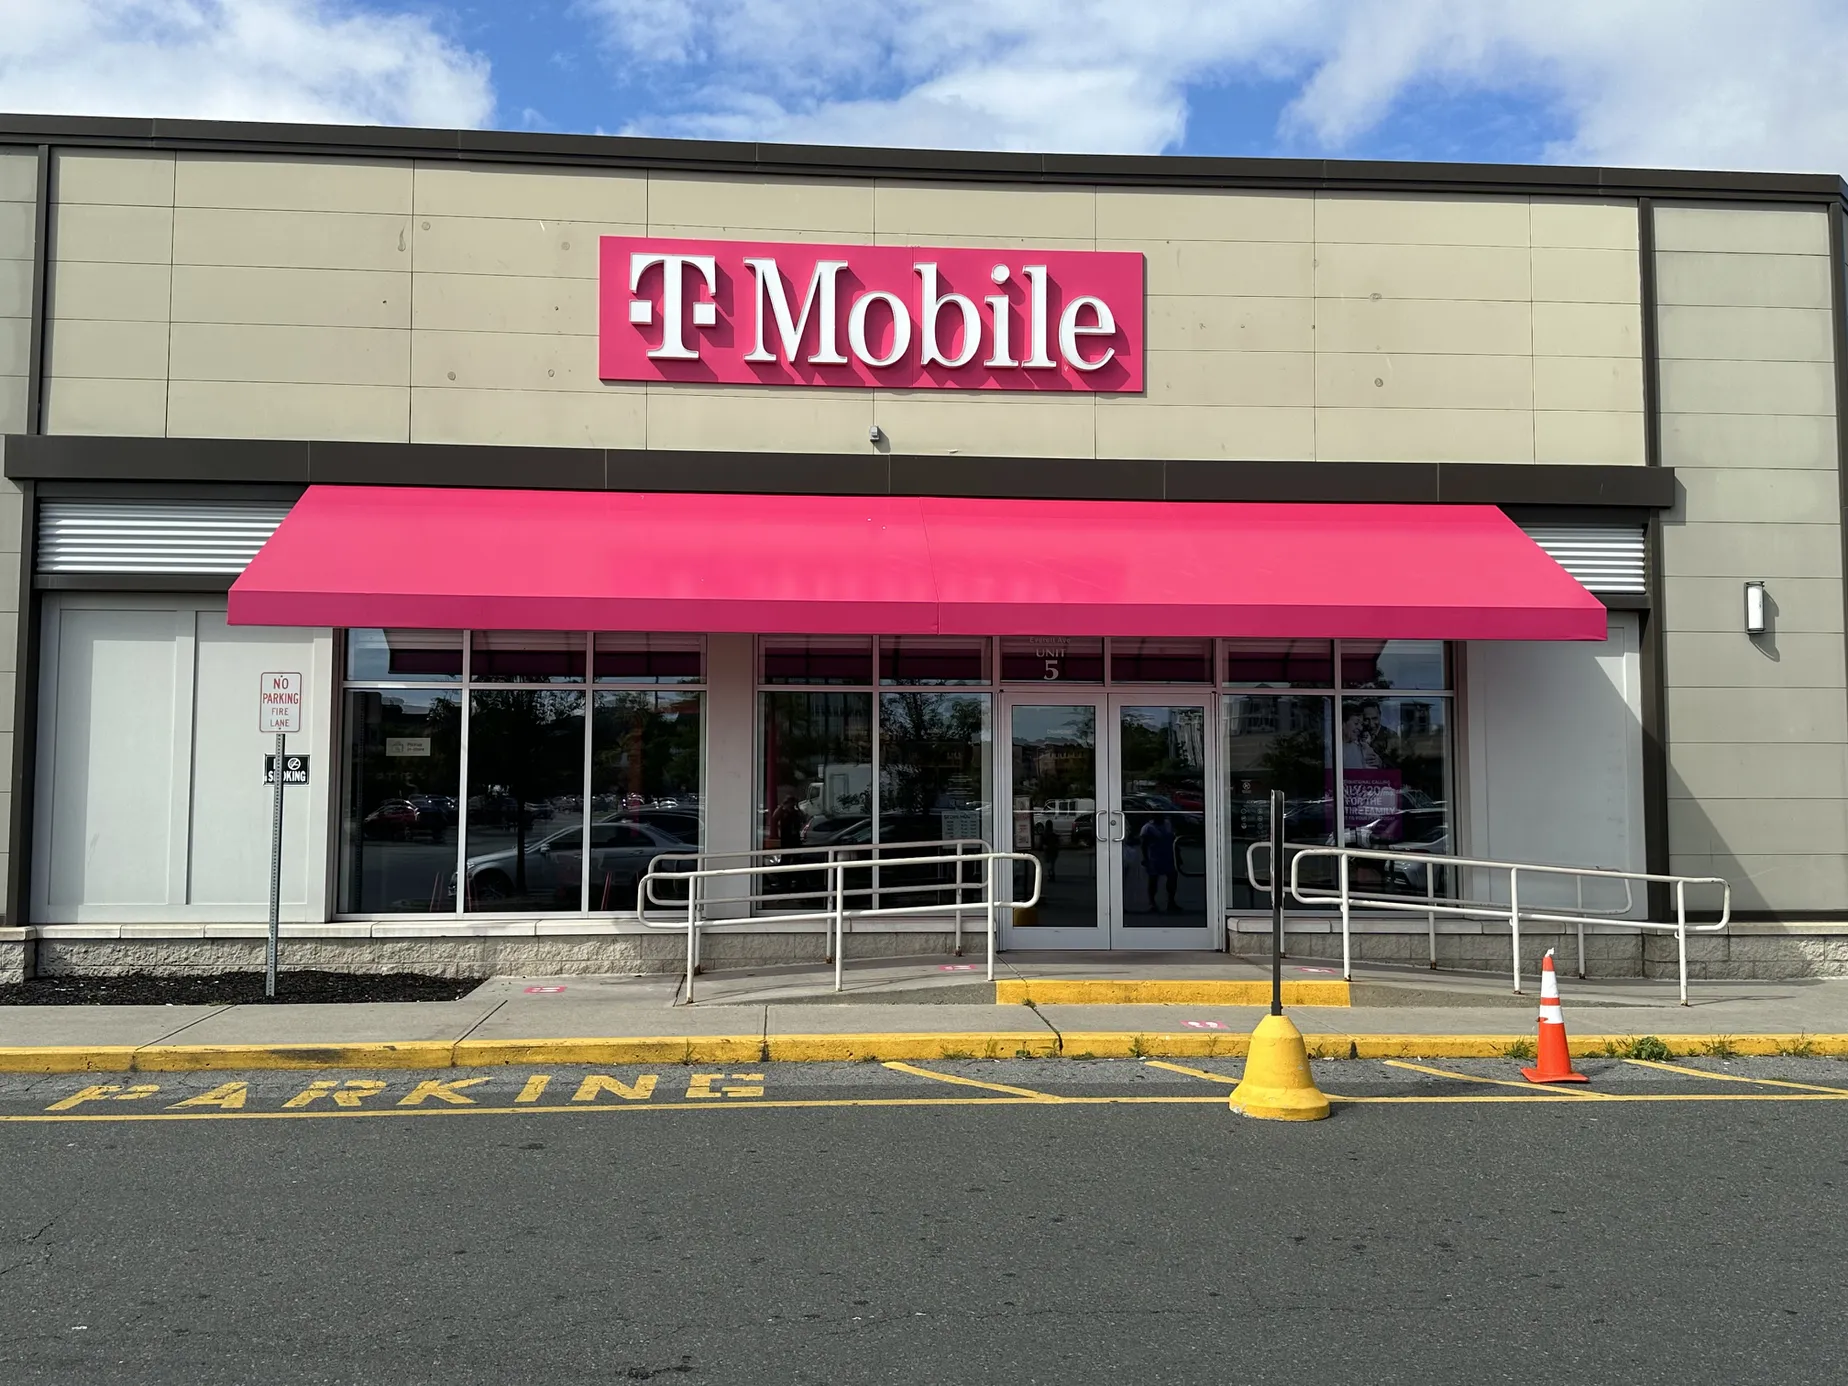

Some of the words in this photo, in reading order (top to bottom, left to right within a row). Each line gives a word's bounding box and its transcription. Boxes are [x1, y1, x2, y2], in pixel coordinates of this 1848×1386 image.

[743, 257, 1117, 372] Mobile
[1035, 648, 1066, 658] UNIT
[1043, 659, 1059, 681] 5
[273, 678, 289, 690] NO
[262, 692, 299, 705] PARKING
[271, 707, 289, 716] FIRE
[270, 718, 290, 728] LANE
[267, 770, 306, 782] SKING
[1344, 806, 1364, 815] TIRE
[1364, 806, 1396, 815] FAMILY
[43, 1073, 765, 1111] PARKING
